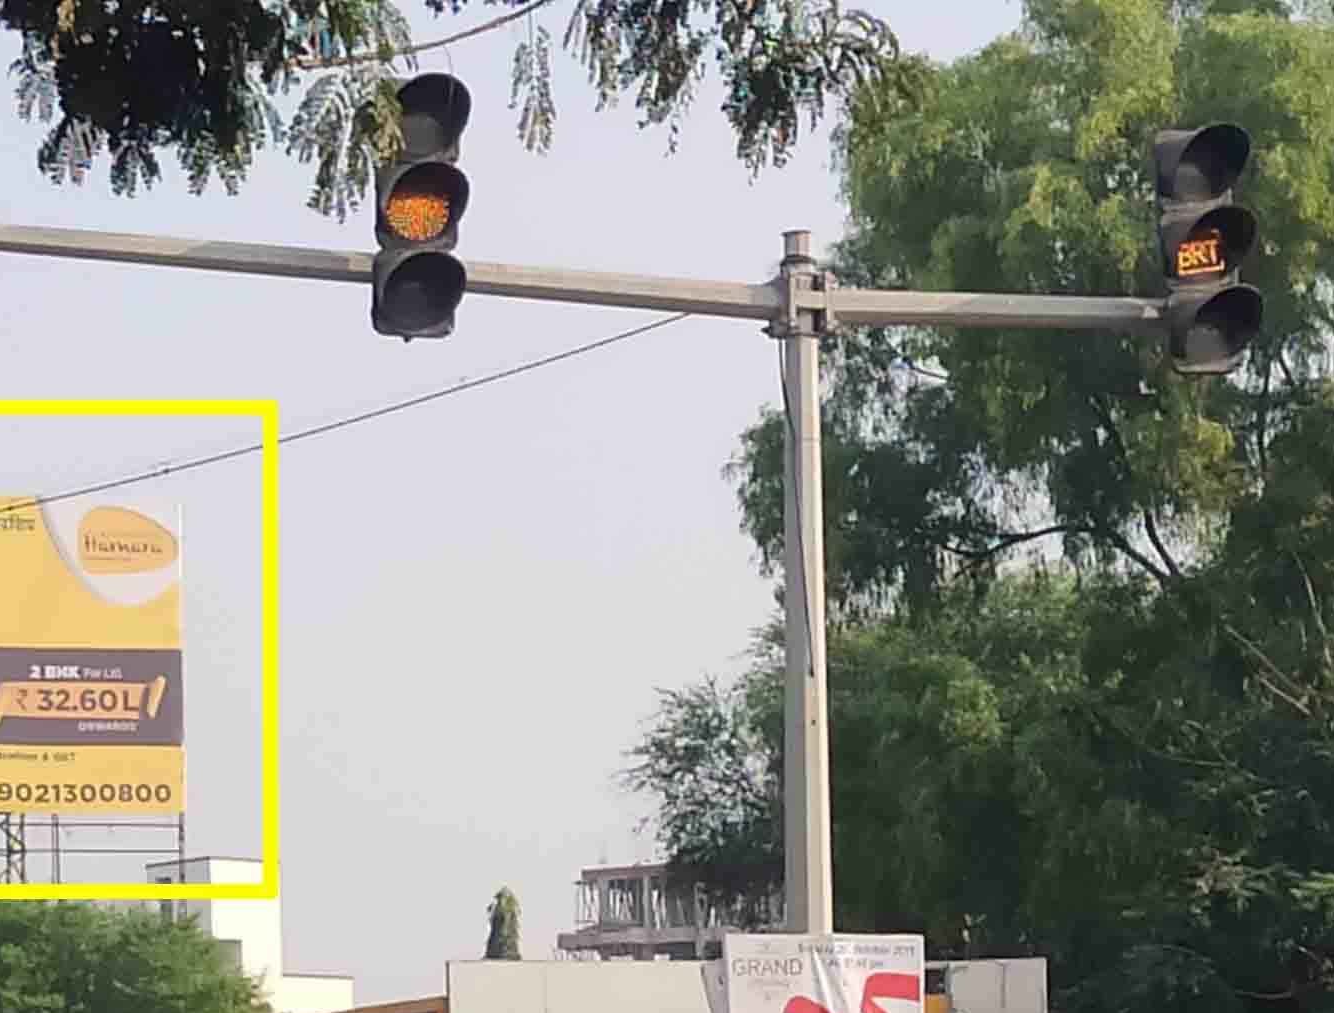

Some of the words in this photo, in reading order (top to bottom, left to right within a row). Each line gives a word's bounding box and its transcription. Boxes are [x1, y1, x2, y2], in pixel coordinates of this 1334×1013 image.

[1178, 240, 1219, 267] BRT
[30, 665, 41, 679] 2
[45, 665, 80, 679] BHK
[732, 957, 804, 977] GRAND
